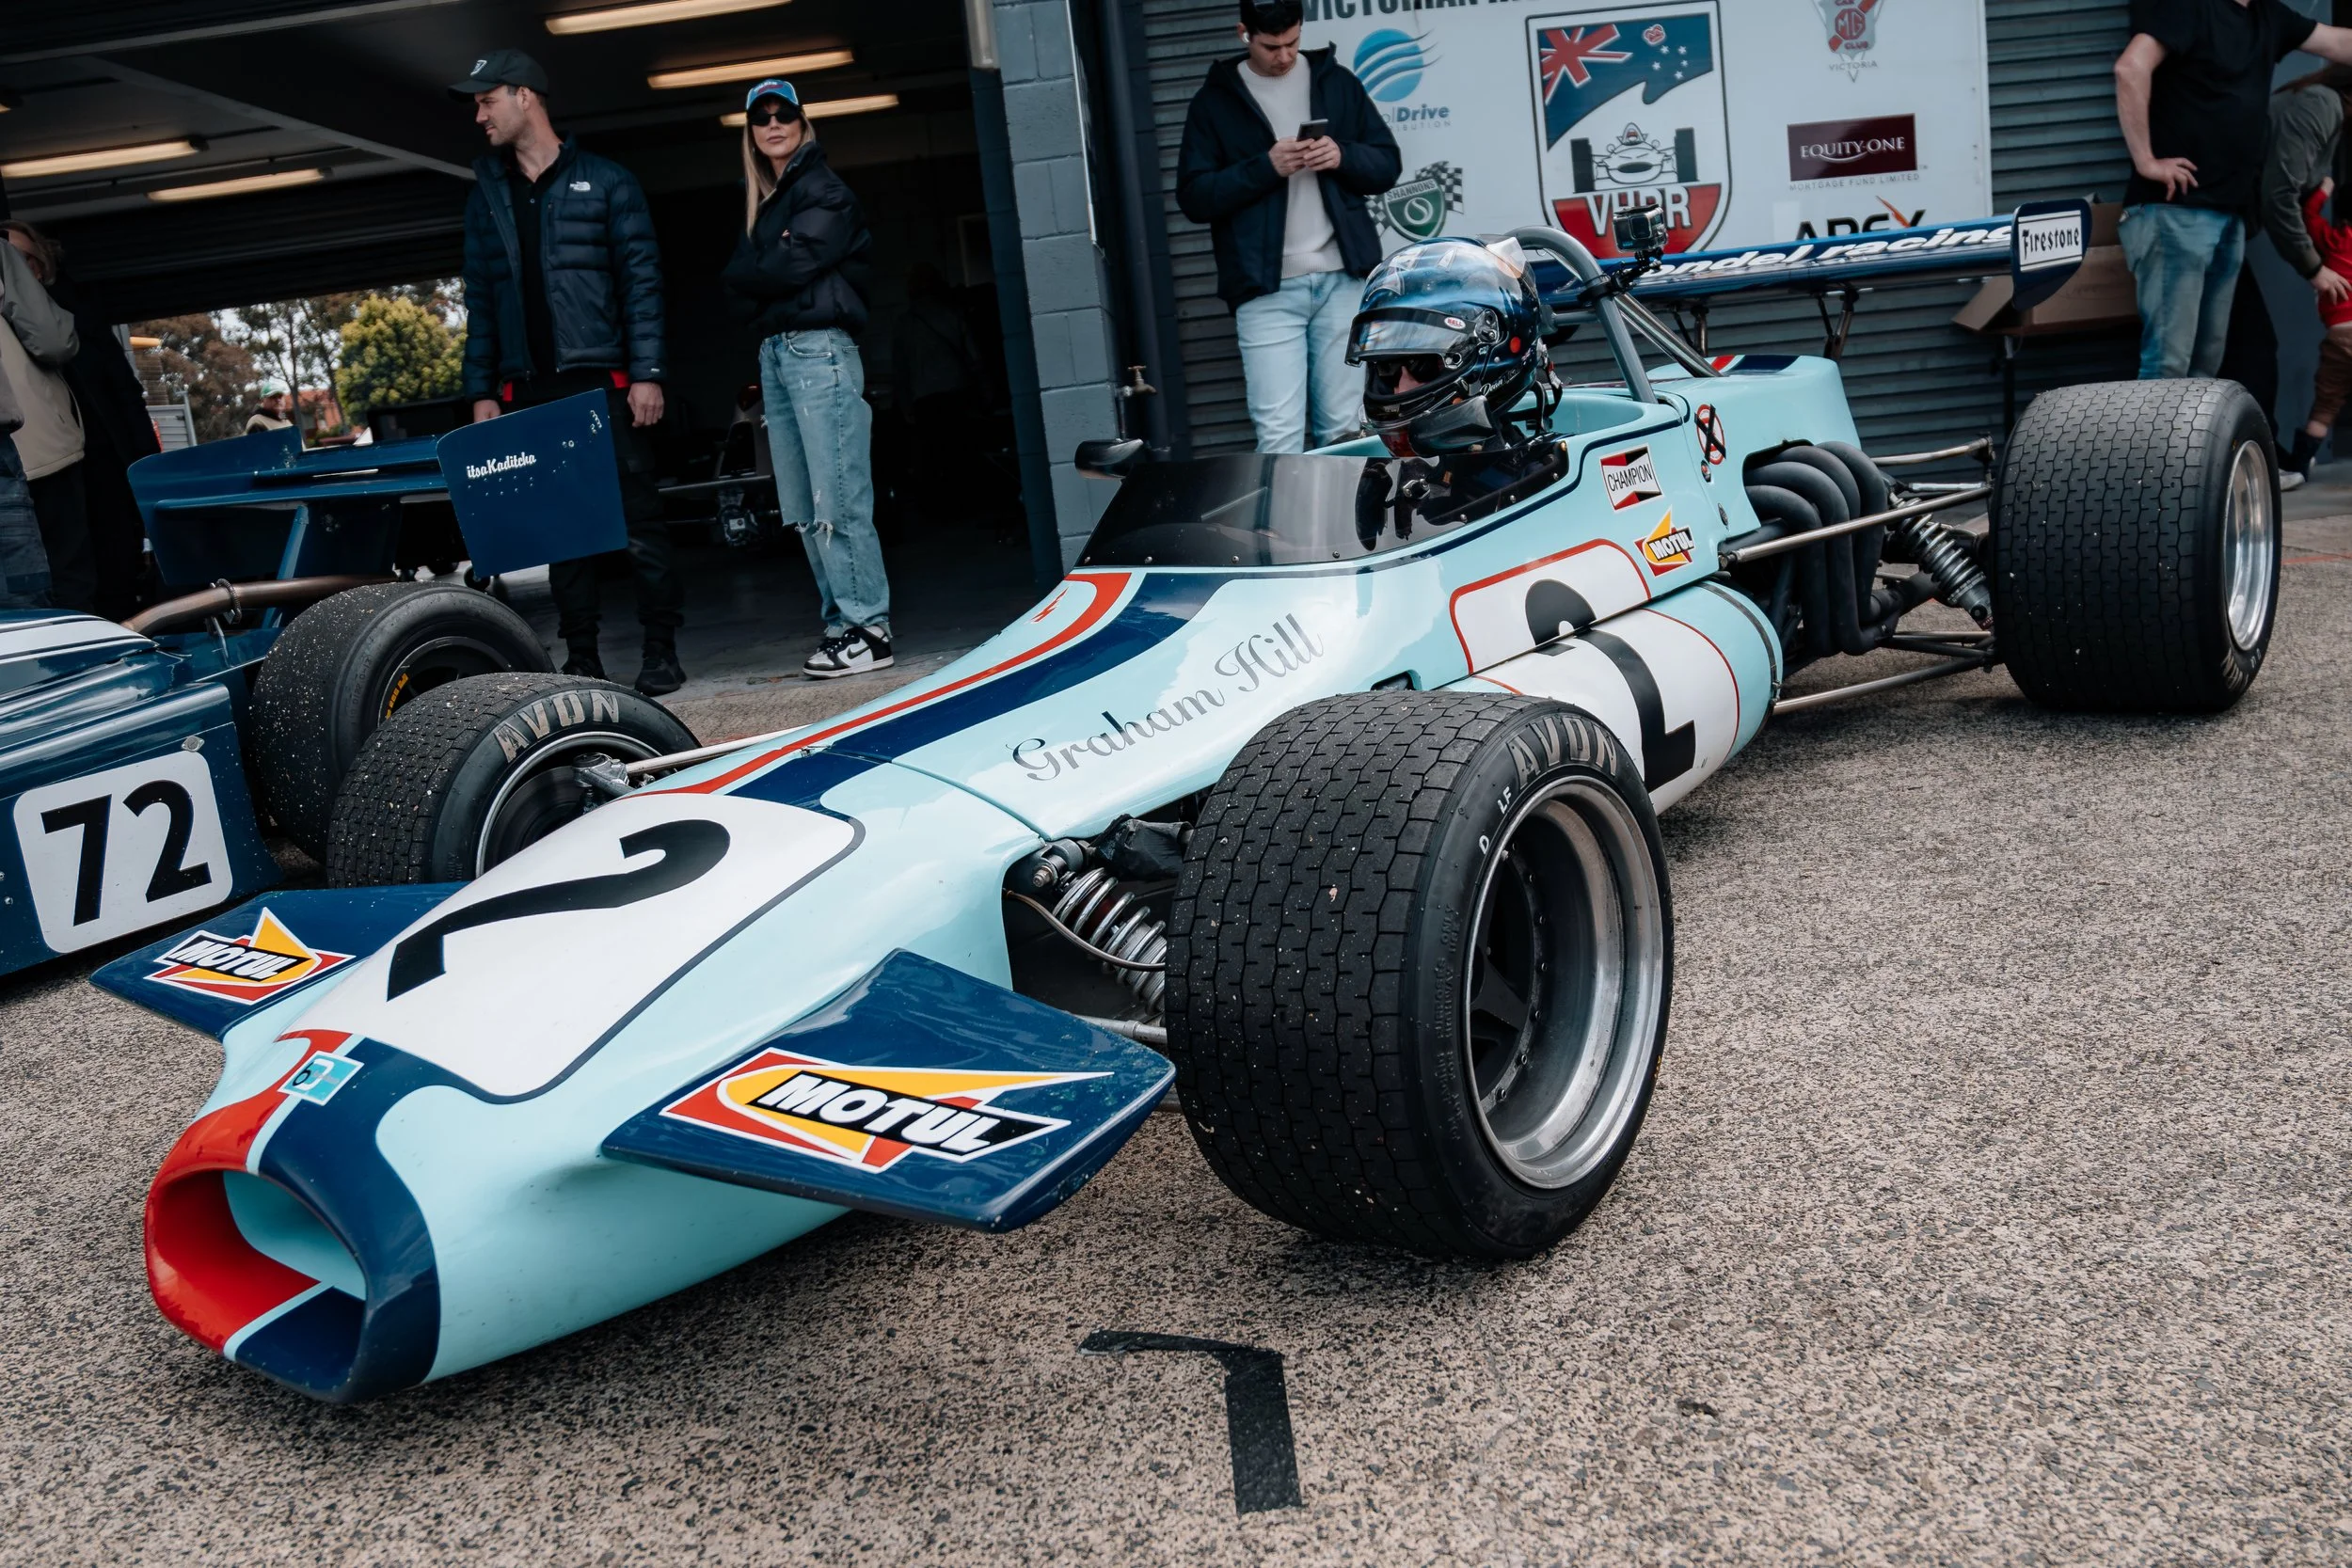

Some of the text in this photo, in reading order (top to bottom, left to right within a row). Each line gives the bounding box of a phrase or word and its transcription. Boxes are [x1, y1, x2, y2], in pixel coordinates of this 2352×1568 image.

[1837, 11, 1864, 37] MG
[1829, 60, 1879, 71] VICTORIA
[1382, 103, 1450, 122] olDrive
[1386, 179, 1437, 201] SHANNONS
[1789, 173, 1920, 192] MORTGAGE FUND LIMITED
[1641, 244, 1814, 278] ondel
[2022, 229, 2080, 261] Firestone
[467, 451, 536, 478] itsaKaditcha
[1607, 463, 1653, 492] CHAMPION
[1648, 531, 1693, 560] MOTUL
[1007, 613, 1326, 782] Graham Hill
[497, 689, 620, 763] AVON
[1506, 716, 1616, 790] AVON
[40, 779, 212, 927] 72
[387, 818, 732, 1003] 2
[167, 940, 297, 980] MOTUL
[756, 1073, 1001, 1152] MOTUL
